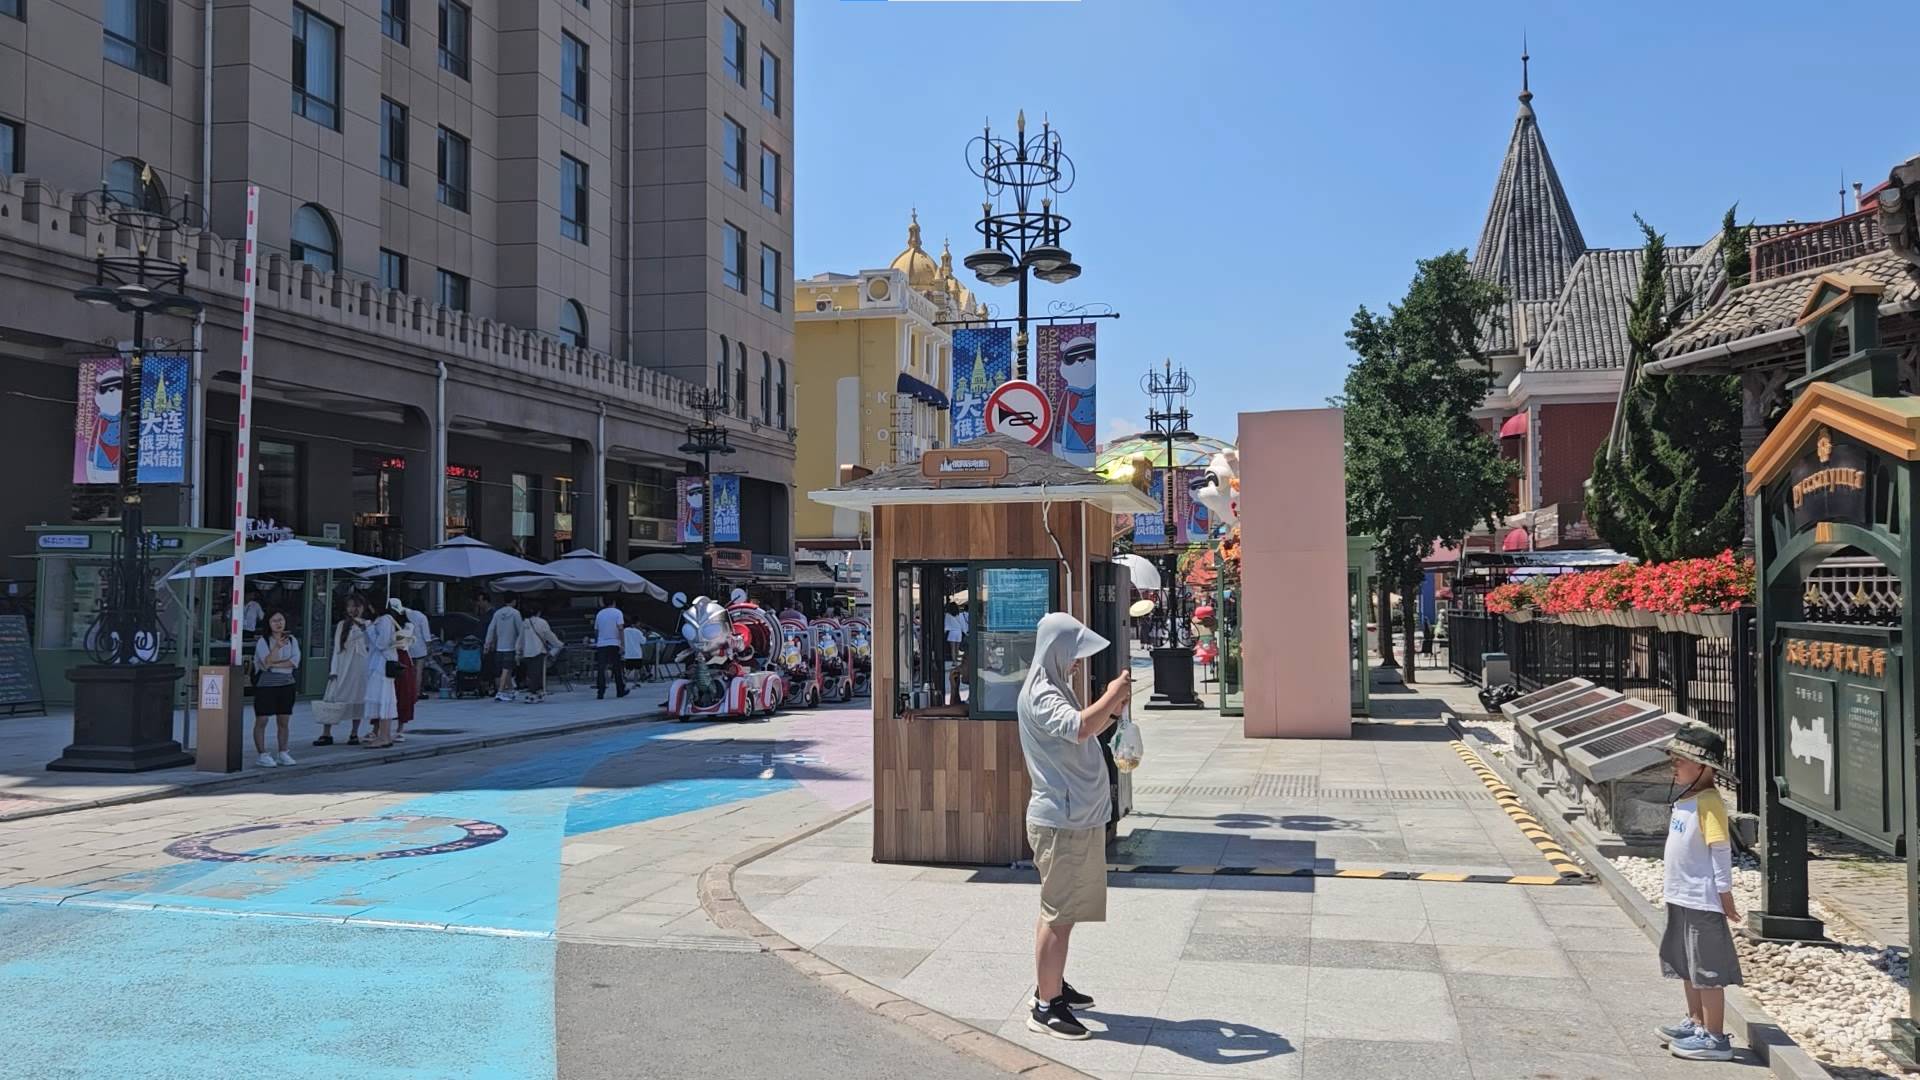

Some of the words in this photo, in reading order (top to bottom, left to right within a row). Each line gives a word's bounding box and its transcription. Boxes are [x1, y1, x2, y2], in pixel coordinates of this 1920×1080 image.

[140, 410, 184, 435] 大连
[140, 434, 182, 450] 俄罗斯
[139, 450, 182, 467] 风情街
